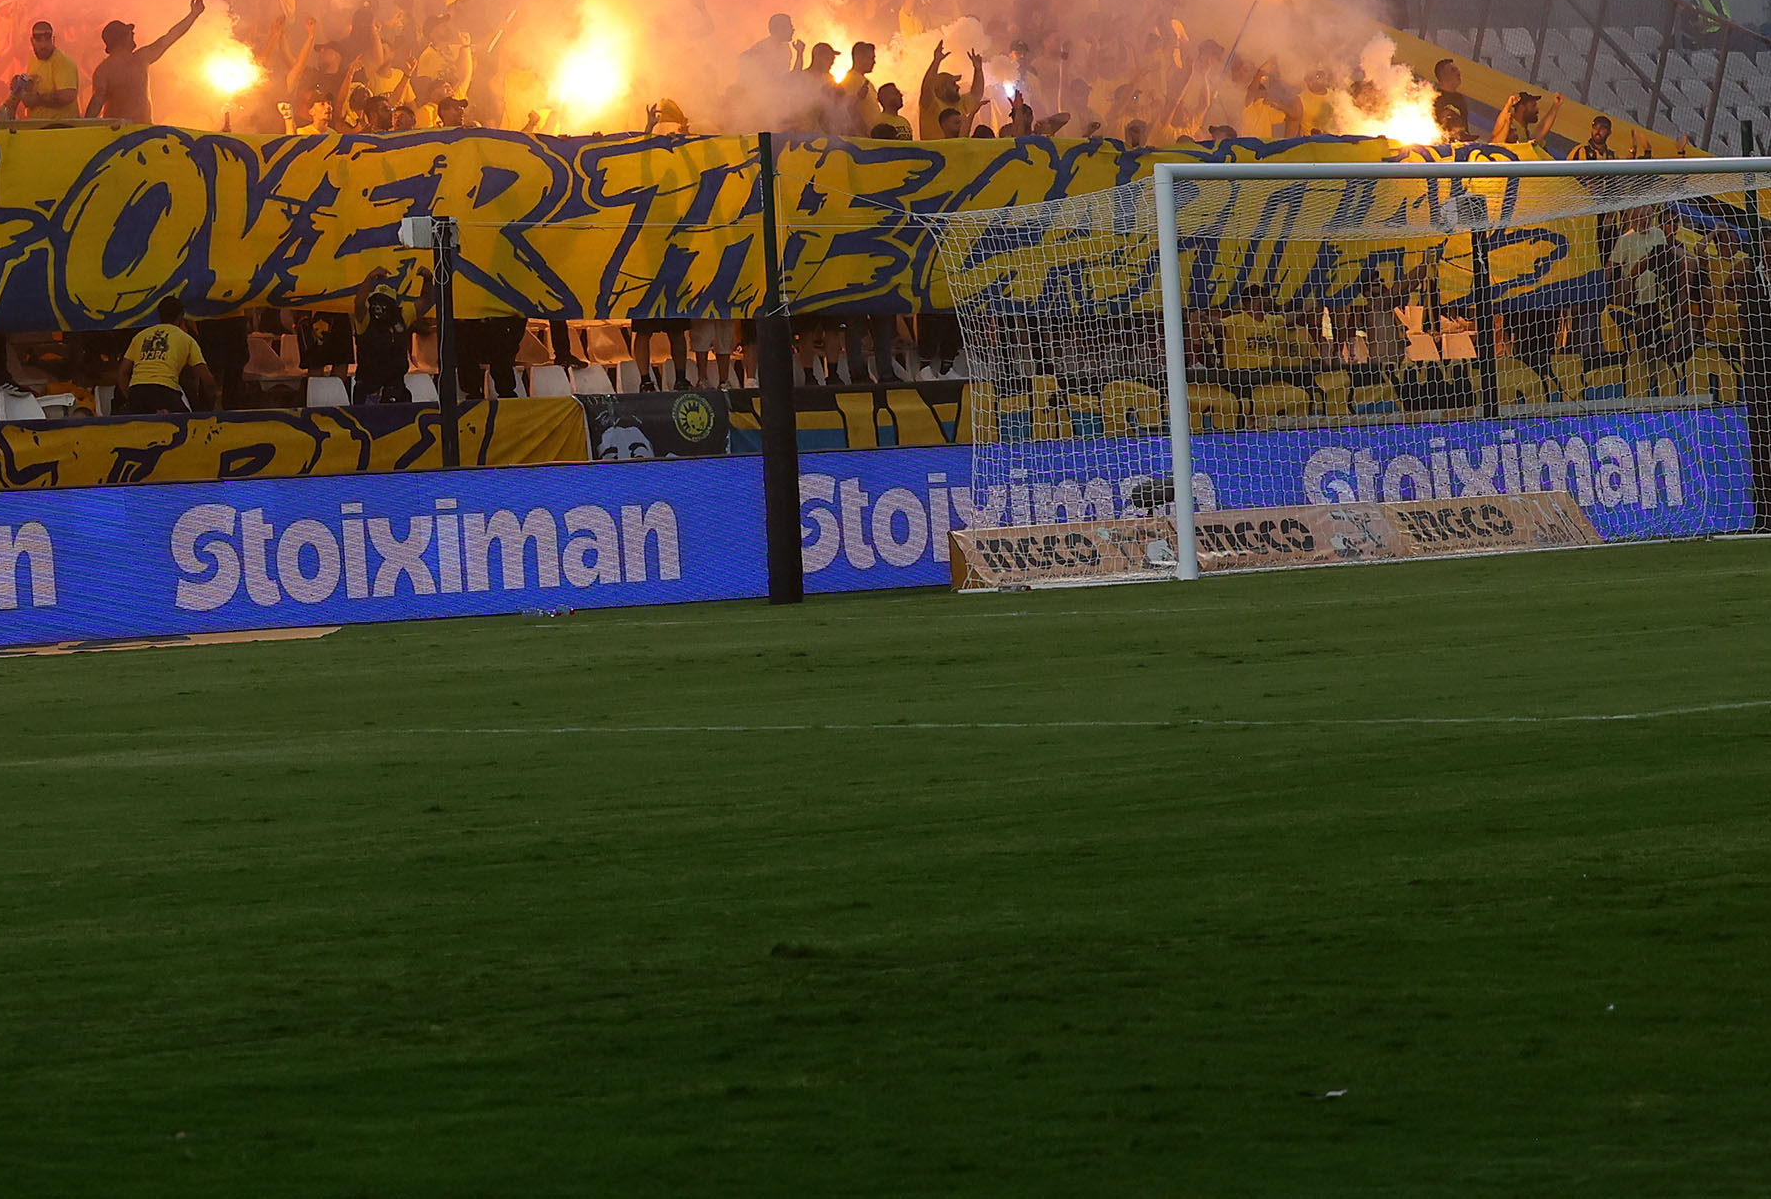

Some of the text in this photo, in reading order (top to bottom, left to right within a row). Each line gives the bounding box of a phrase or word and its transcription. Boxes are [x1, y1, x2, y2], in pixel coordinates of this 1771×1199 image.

[56, 126, 582, 319] OVER
[576, 131, 946, 319] THE
[1303, 430, 1684, 510] Stoiximan
[170, 497, 683, 612] Stoiximan
